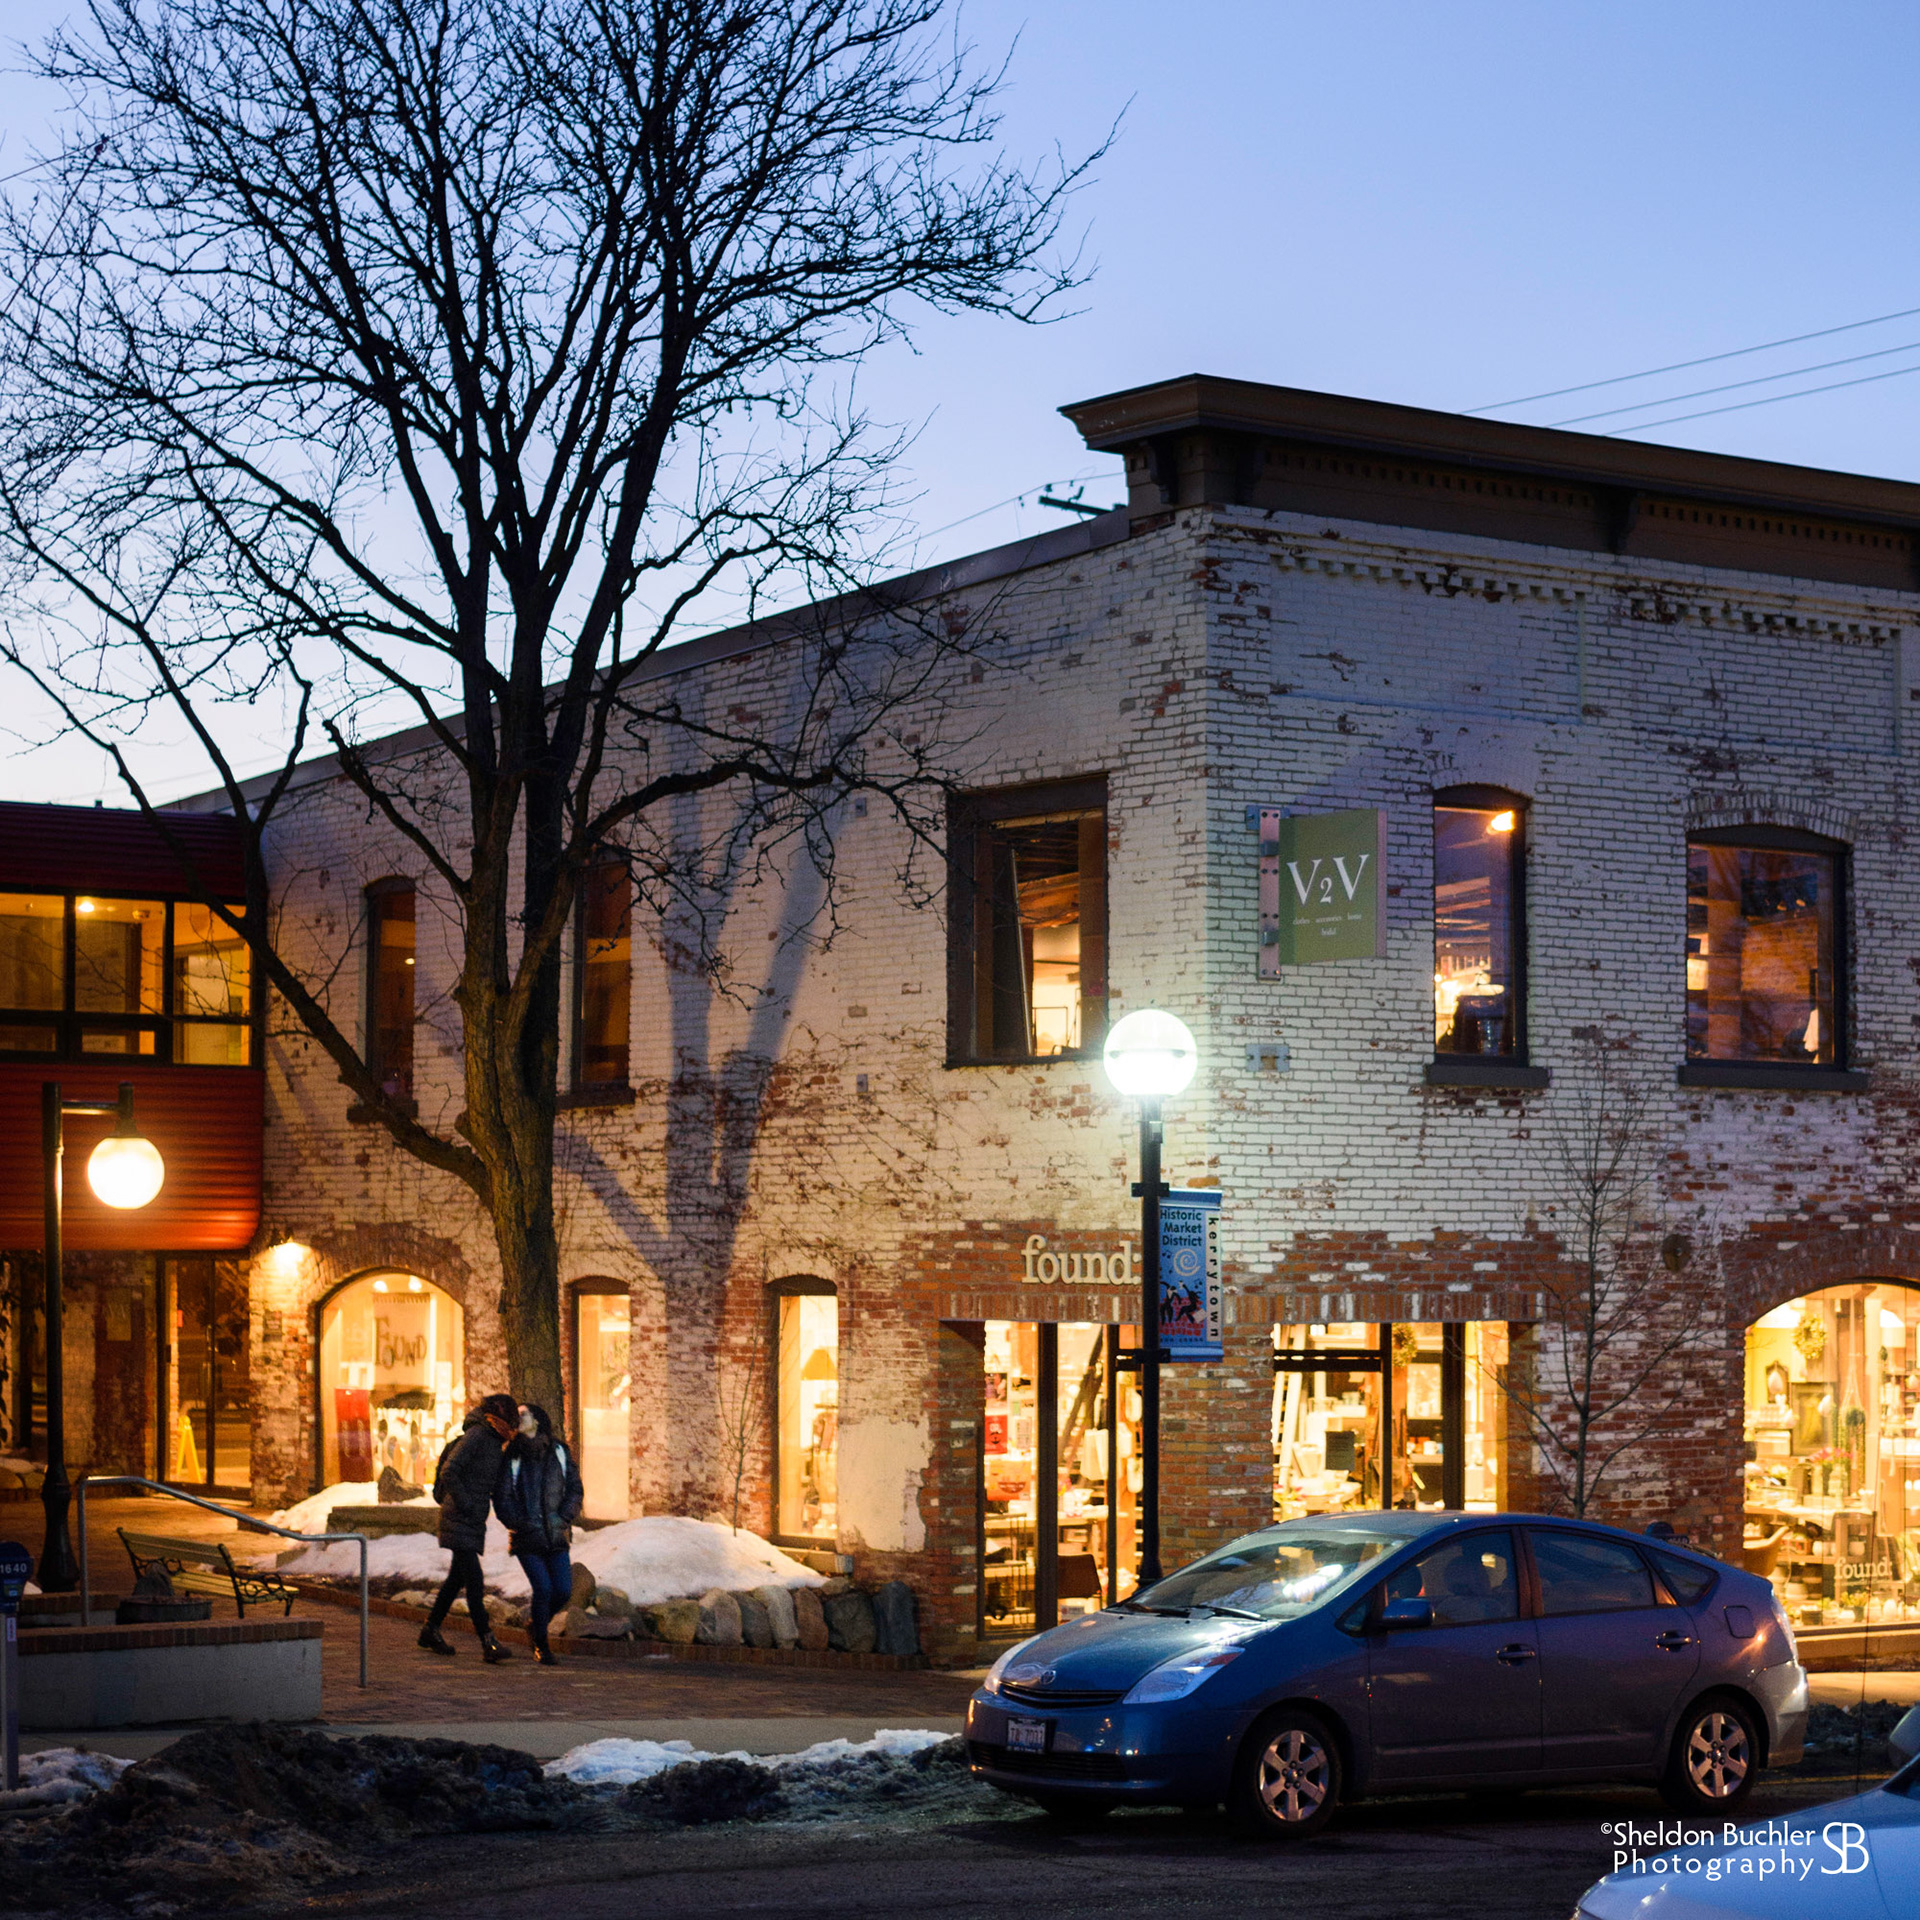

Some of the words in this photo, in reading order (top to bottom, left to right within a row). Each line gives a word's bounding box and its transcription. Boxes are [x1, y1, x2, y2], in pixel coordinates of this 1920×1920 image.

[1286, 854, 1370, 905] V2V
[1160, 1208, 1202, 1221] Historic
[1163, 1221, 1202, 1234] Market
[1162, 1234, 1202, 1247] District
[1207, 1216, 1221, 1338] kerrytown
